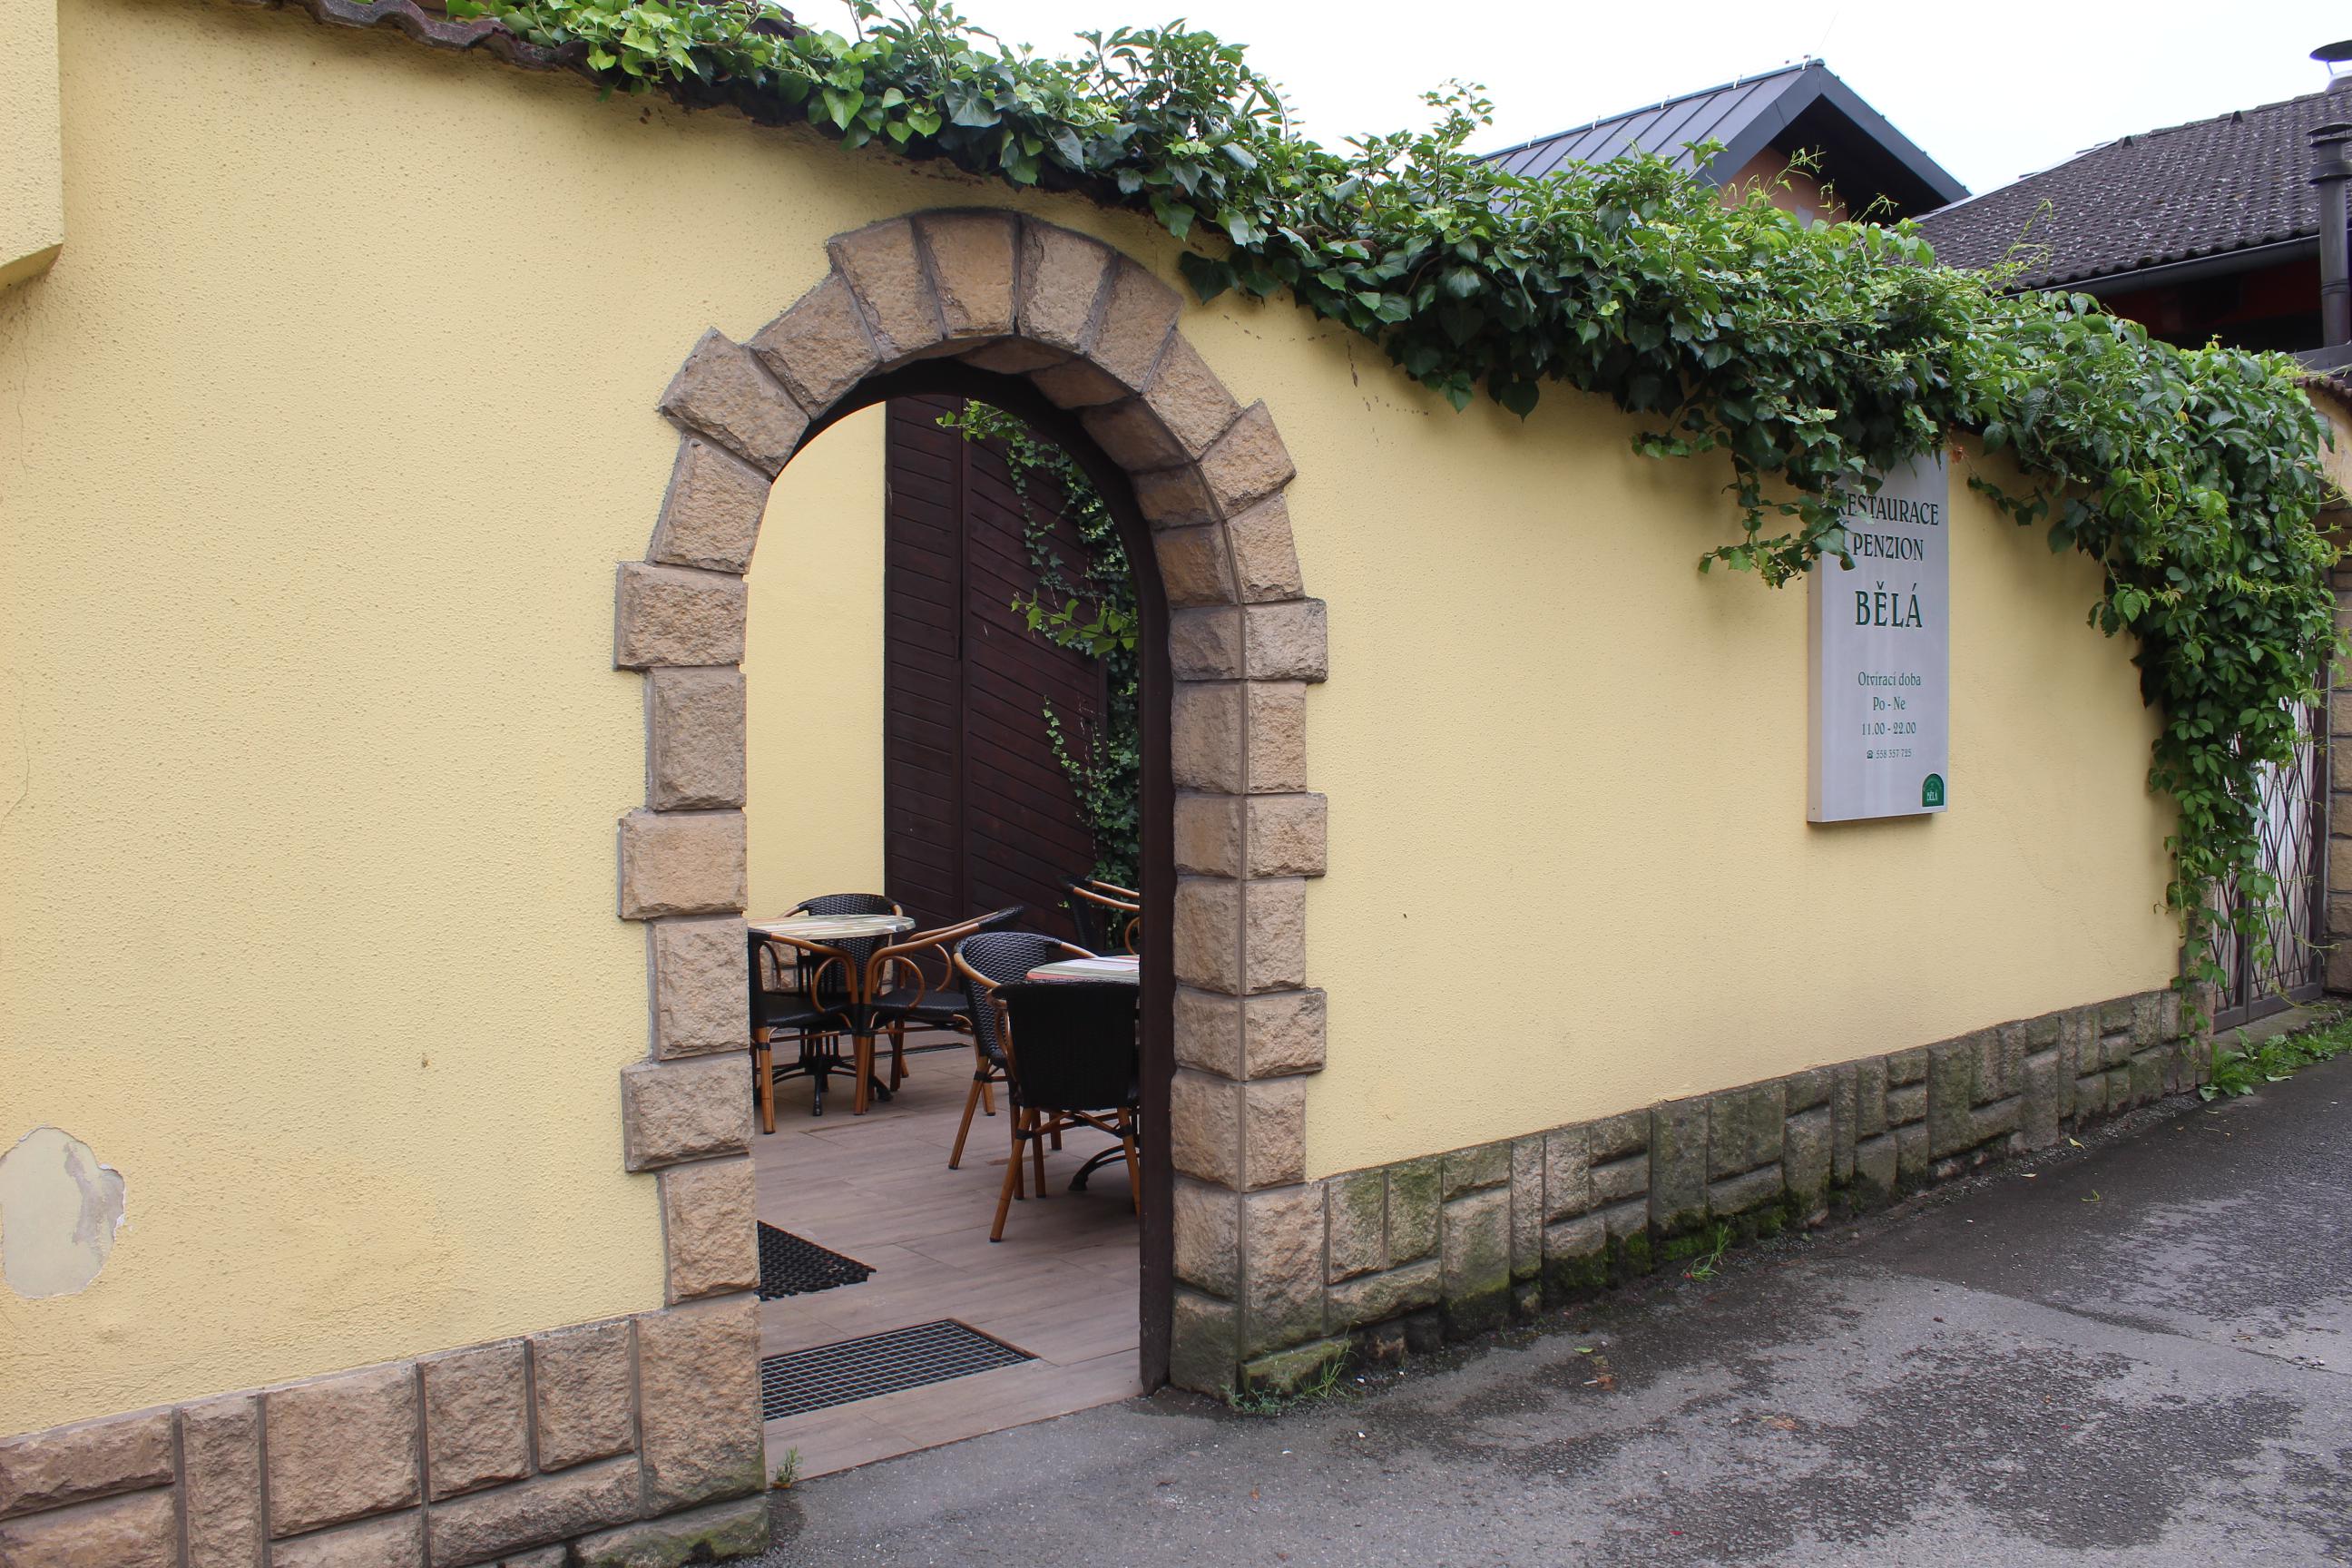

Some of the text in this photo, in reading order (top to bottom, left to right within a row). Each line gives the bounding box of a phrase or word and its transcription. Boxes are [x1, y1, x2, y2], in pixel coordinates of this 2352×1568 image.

[1853, 533, 1923, 561] PENZION
[1855, 581, 1923, 628] BĚLÁ
[1898, 672, 1921, 686] doba
[1873, 697, 1886, 710] Po
[1893, 696, 1906, 710] Ne
[1862, 722, 1885, 736] 11.00
[1893, 722, 1916, 735] 22.00
